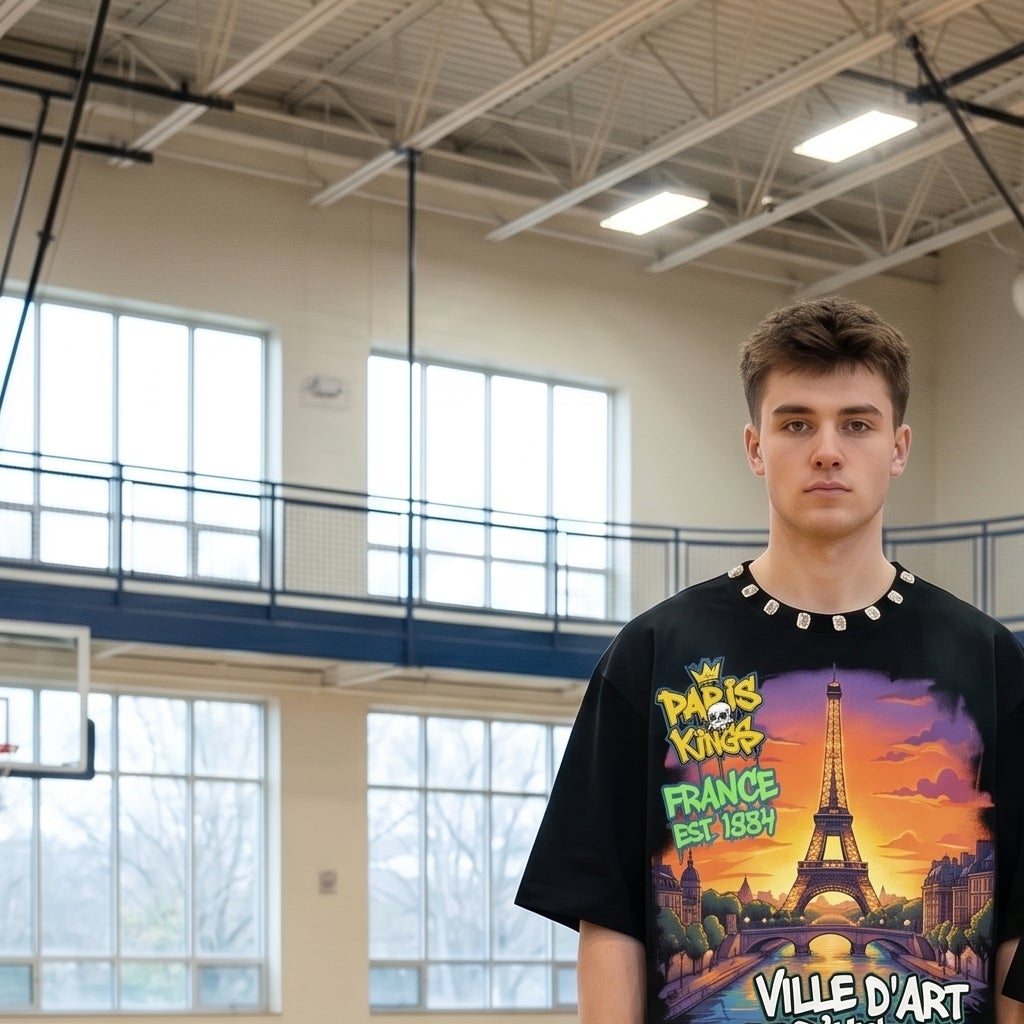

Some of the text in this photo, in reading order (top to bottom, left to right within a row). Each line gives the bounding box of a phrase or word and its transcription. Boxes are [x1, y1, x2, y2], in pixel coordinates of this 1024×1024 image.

[669, 716, 765, 764] KINGS
[663, 768, 778, 818] FRANCE
[722, 808, 776, 839] 1884
[756, 969, 970, 1022] VILLE D'ART
